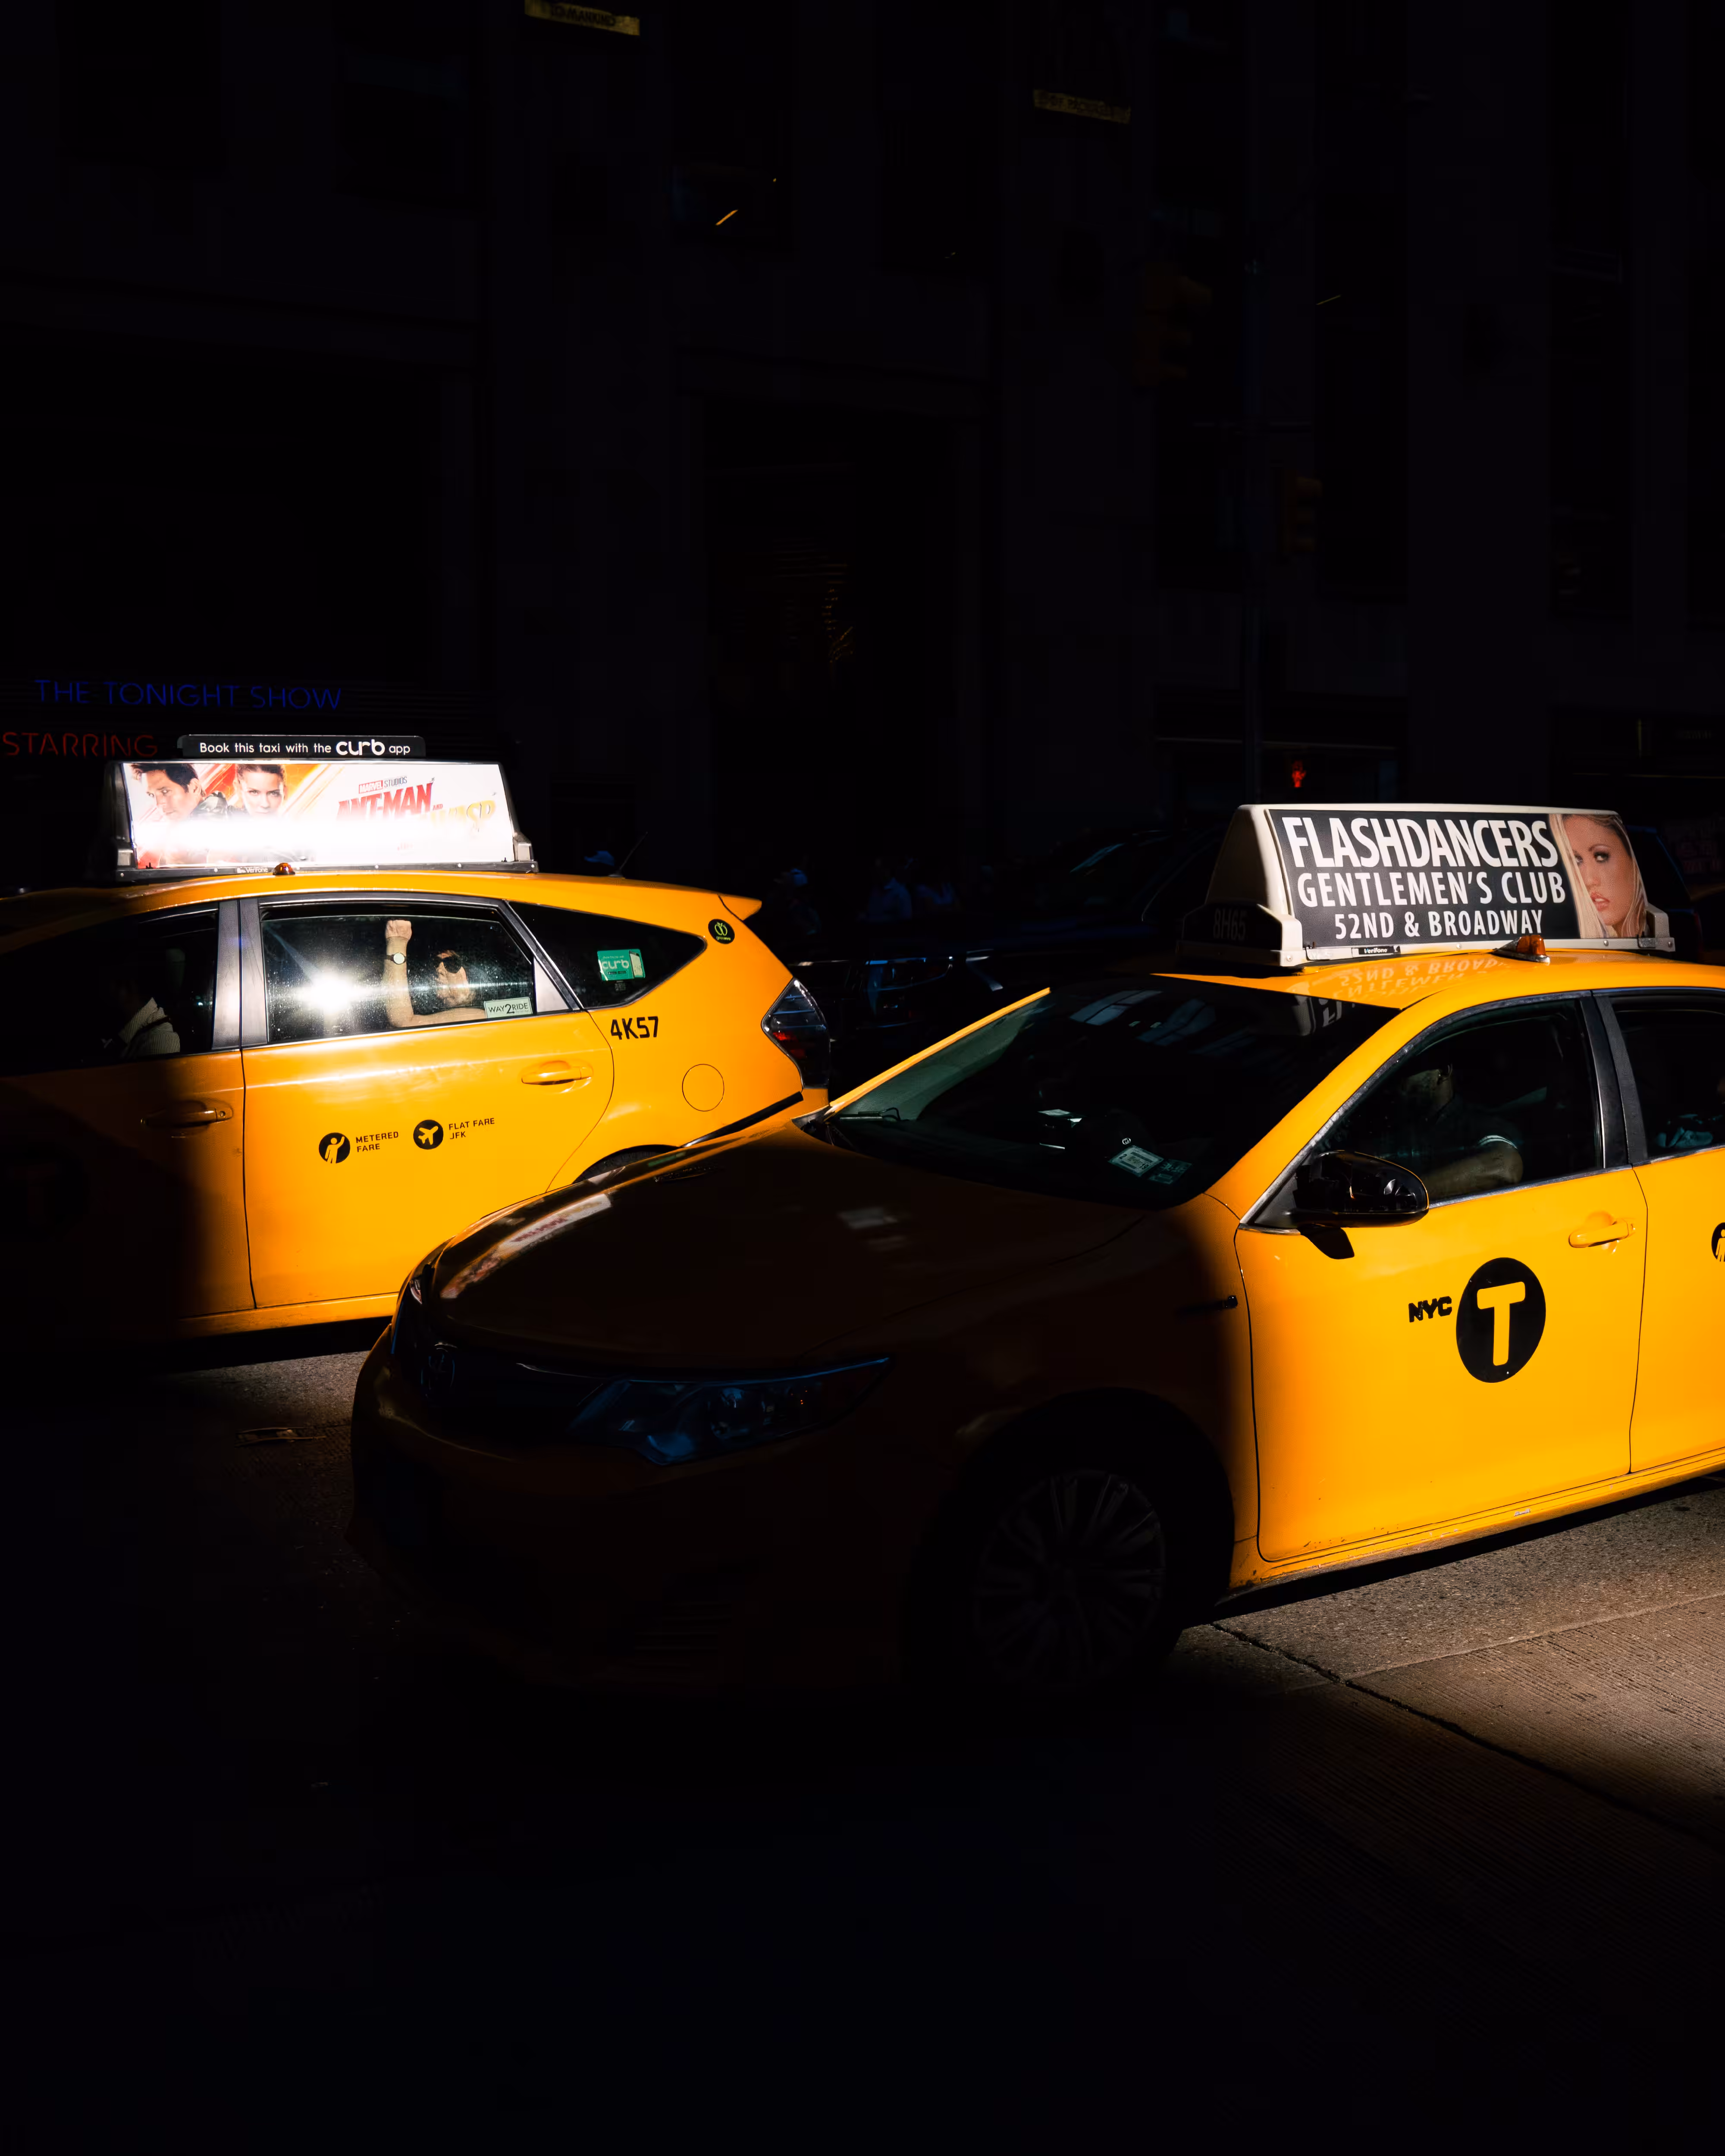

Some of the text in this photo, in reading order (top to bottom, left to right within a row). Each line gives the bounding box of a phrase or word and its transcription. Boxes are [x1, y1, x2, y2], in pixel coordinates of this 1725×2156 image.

[34, 679, 342, 711] THE TONIGHT SHOW
[0, 731, 158, 758] STARRING
[200, 739, 411, 755] Book this taxi with the curb app
[359, 776, 408, 794] MARVEL STUDIOS
[336, 781, 433, 821] ANT-MAN
[1282, 817, 1558, 868] FLASHDANCERS
[1298, 871, 1566, 908] GENTLEMEN'S CLUB
[1334, 909, 1542, 940] 52ND & BROADWAY
[602, 959, 629, 969] curb
[488, 1003, 529, 1014] WAY2RIDE
[611, 1016, 659, 1040] 4K57
[449, 1118, 495, 1130] FLAT FARE
[356, 1131, 399, 1143] METERED
[450, 1131, 466, 1140] JFK
[357, 1144, 380, 1153] FARE
[1408, 1281, 1526, 1366] NYC T
